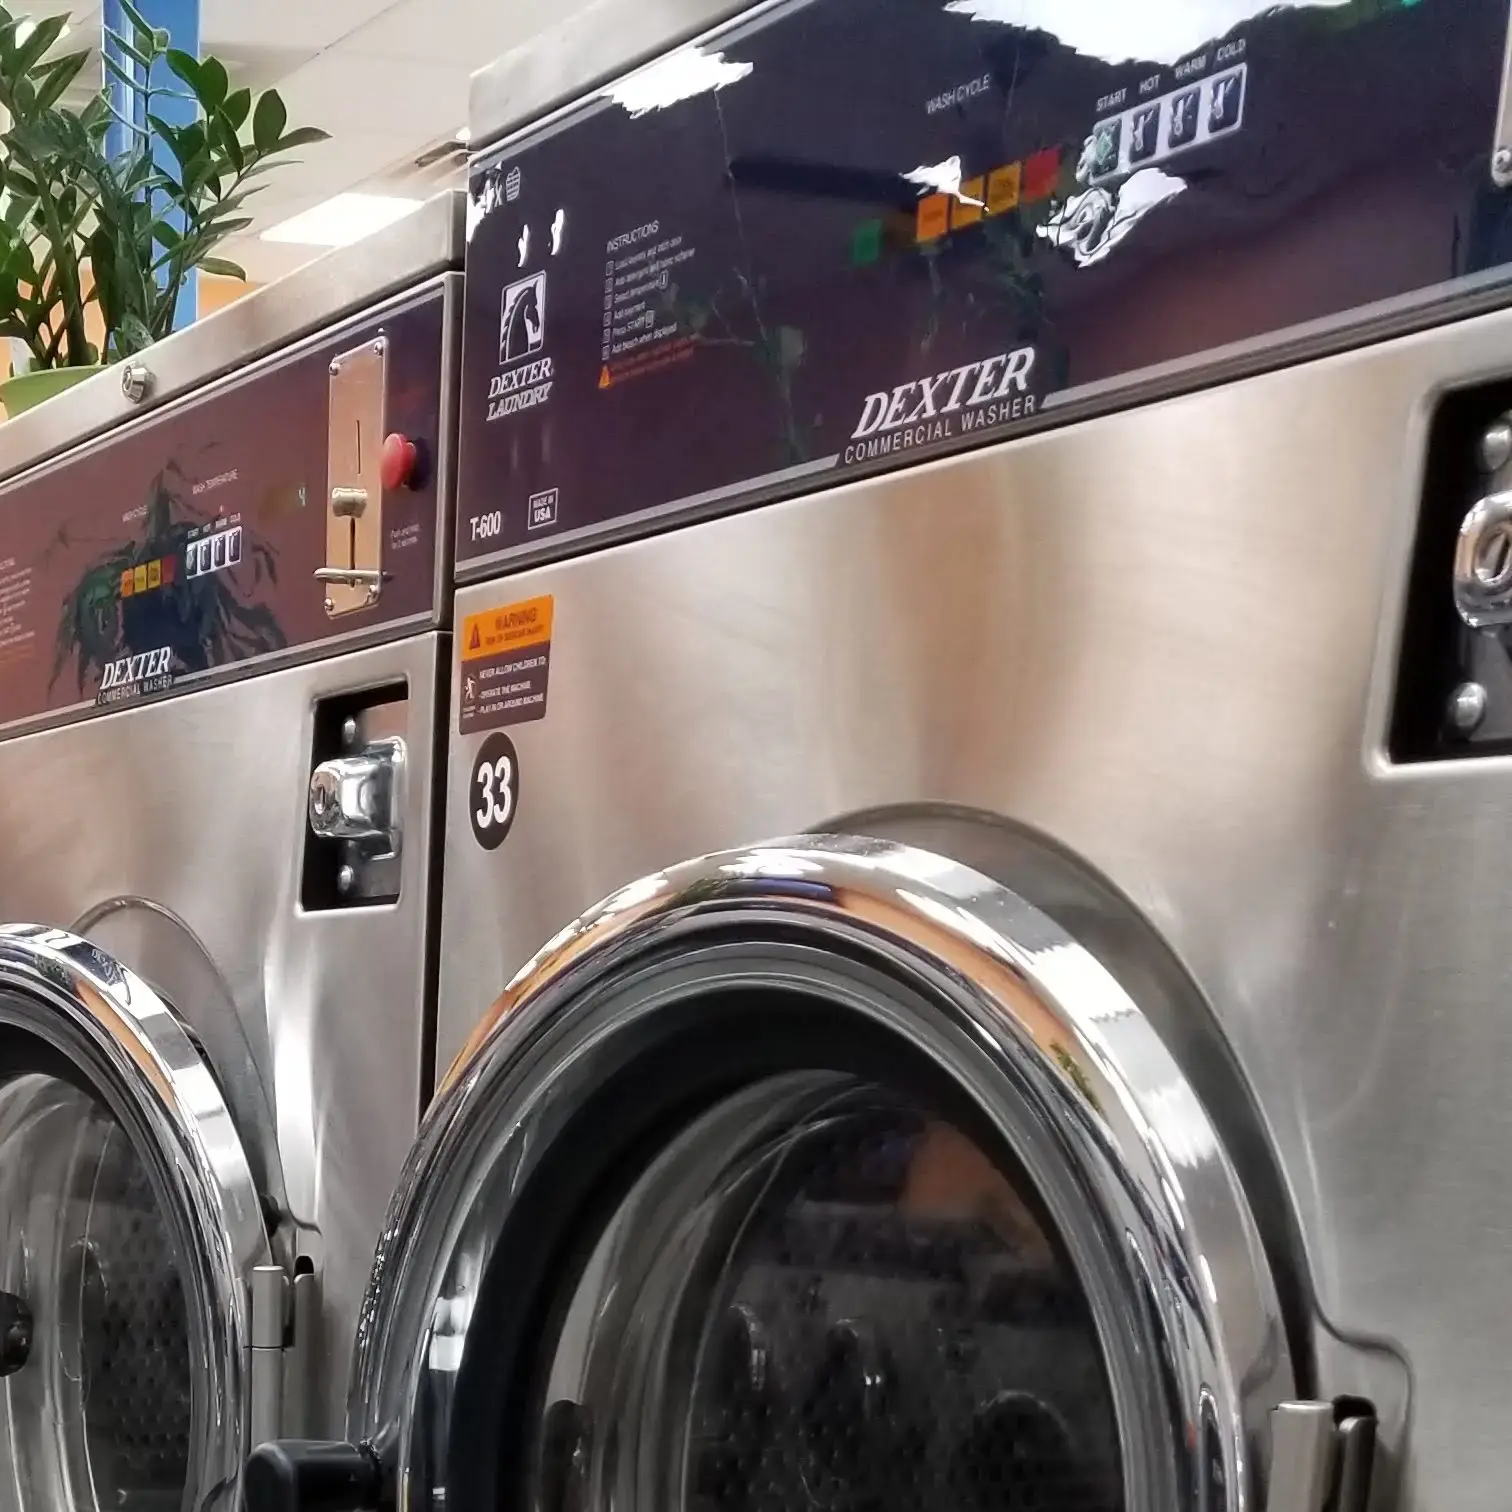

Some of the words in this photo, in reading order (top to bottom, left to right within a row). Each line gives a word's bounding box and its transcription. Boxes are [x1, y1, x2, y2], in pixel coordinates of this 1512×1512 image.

[925, 89, 956, 115] WASH
[956, 73, 991, 103] CYCLE
[1096, 88, 1127, 112] START
[1139, 74, 1160, 94] HOT
[1175, 54, 1207, 79] WARM
[1217, 39, 1246, 61] COLD
[606, 219, 660, 254] INSTRUCTIONS
[488, 357, 553, 399] DEXTER
[850, 346, 1036, 440] DEXTER
[486, 382, 553, 421] LAUNDRY
[844, 418, 953, 465] COMMERCIAL
[961, 394, 1036, 432] WASHER
[470, 511, 502, 542] T-600
[534, 507, 552, 523] USA
[495, 607, 538, 631] WARNING
[99, 646, 171, 690] DEXTER
[97, 683, 141, 706] COMMERCIAL
[143, 674, 173, 693] WASHER
[476, 755, 511, 829] 33
